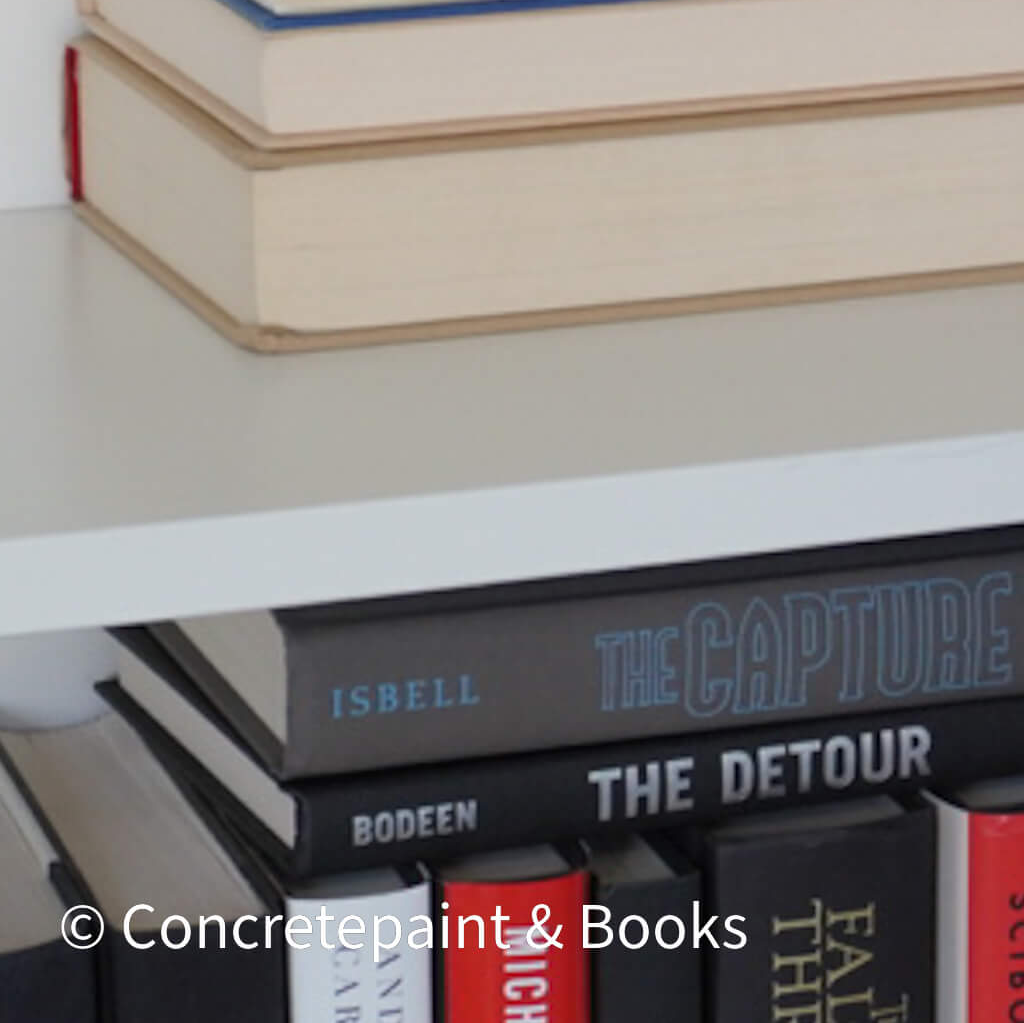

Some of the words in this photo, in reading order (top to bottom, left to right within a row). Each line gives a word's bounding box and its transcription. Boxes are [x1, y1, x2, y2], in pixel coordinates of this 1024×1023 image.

[595, 627, 679, 712] THE
[684, 571, 1013, 717] CAPTURE
[331, 674, 480, 719] ISBELL
[588, 757, 694, 822] THE
[721, 724, 932, 804] DETOUR
[352, 798, 478, 847] BODEEN
